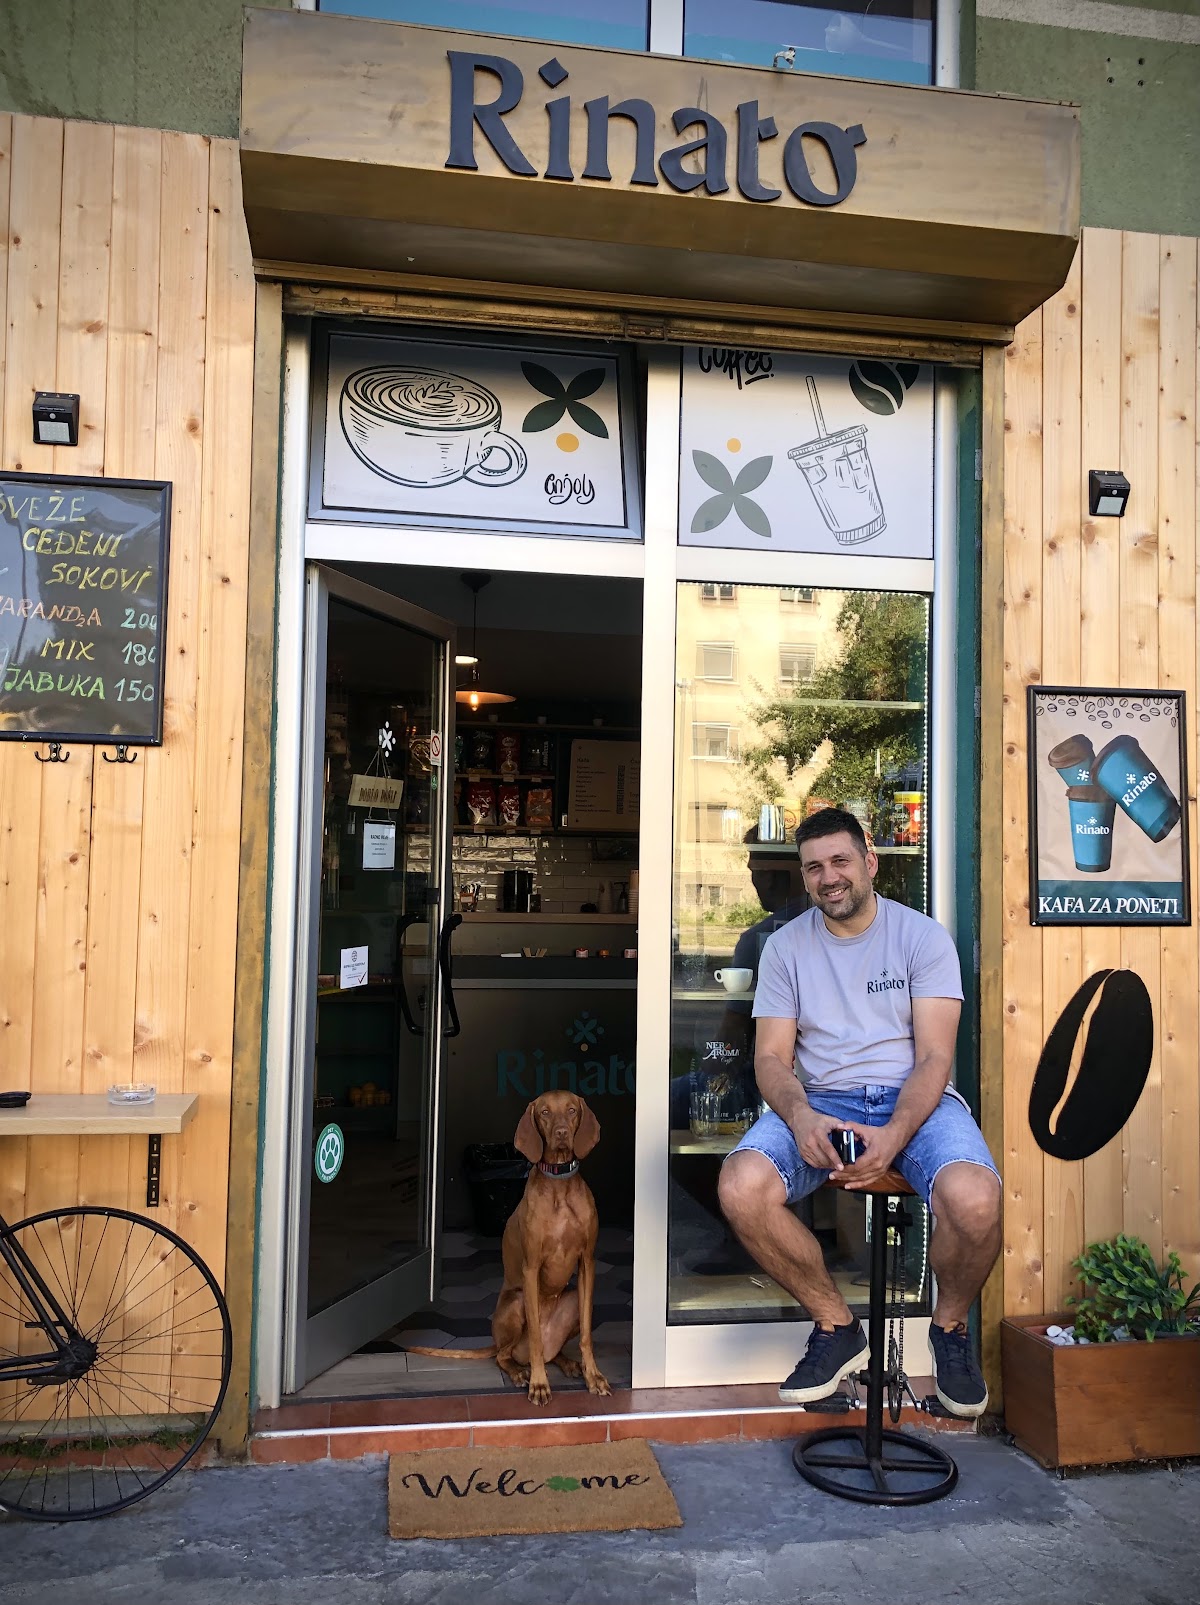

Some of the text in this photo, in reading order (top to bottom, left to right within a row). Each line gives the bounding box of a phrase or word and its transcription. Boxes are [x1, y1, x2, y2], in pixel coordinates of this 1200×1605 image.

[445, 50, 868, 207] Rinato
[45, 562, 152, 594] SOKOVI
[40, 637, 95, 661] MIX
[5, 663, 154, 702] JABUKA 150
[1122, 771, 1157, 807] Rinato
[1076, 824, 1110, 835] Rinato
[1038, 896, 1179, 914] KAFA ZA PONETI
[867, 978, 905, 994] Rinato
